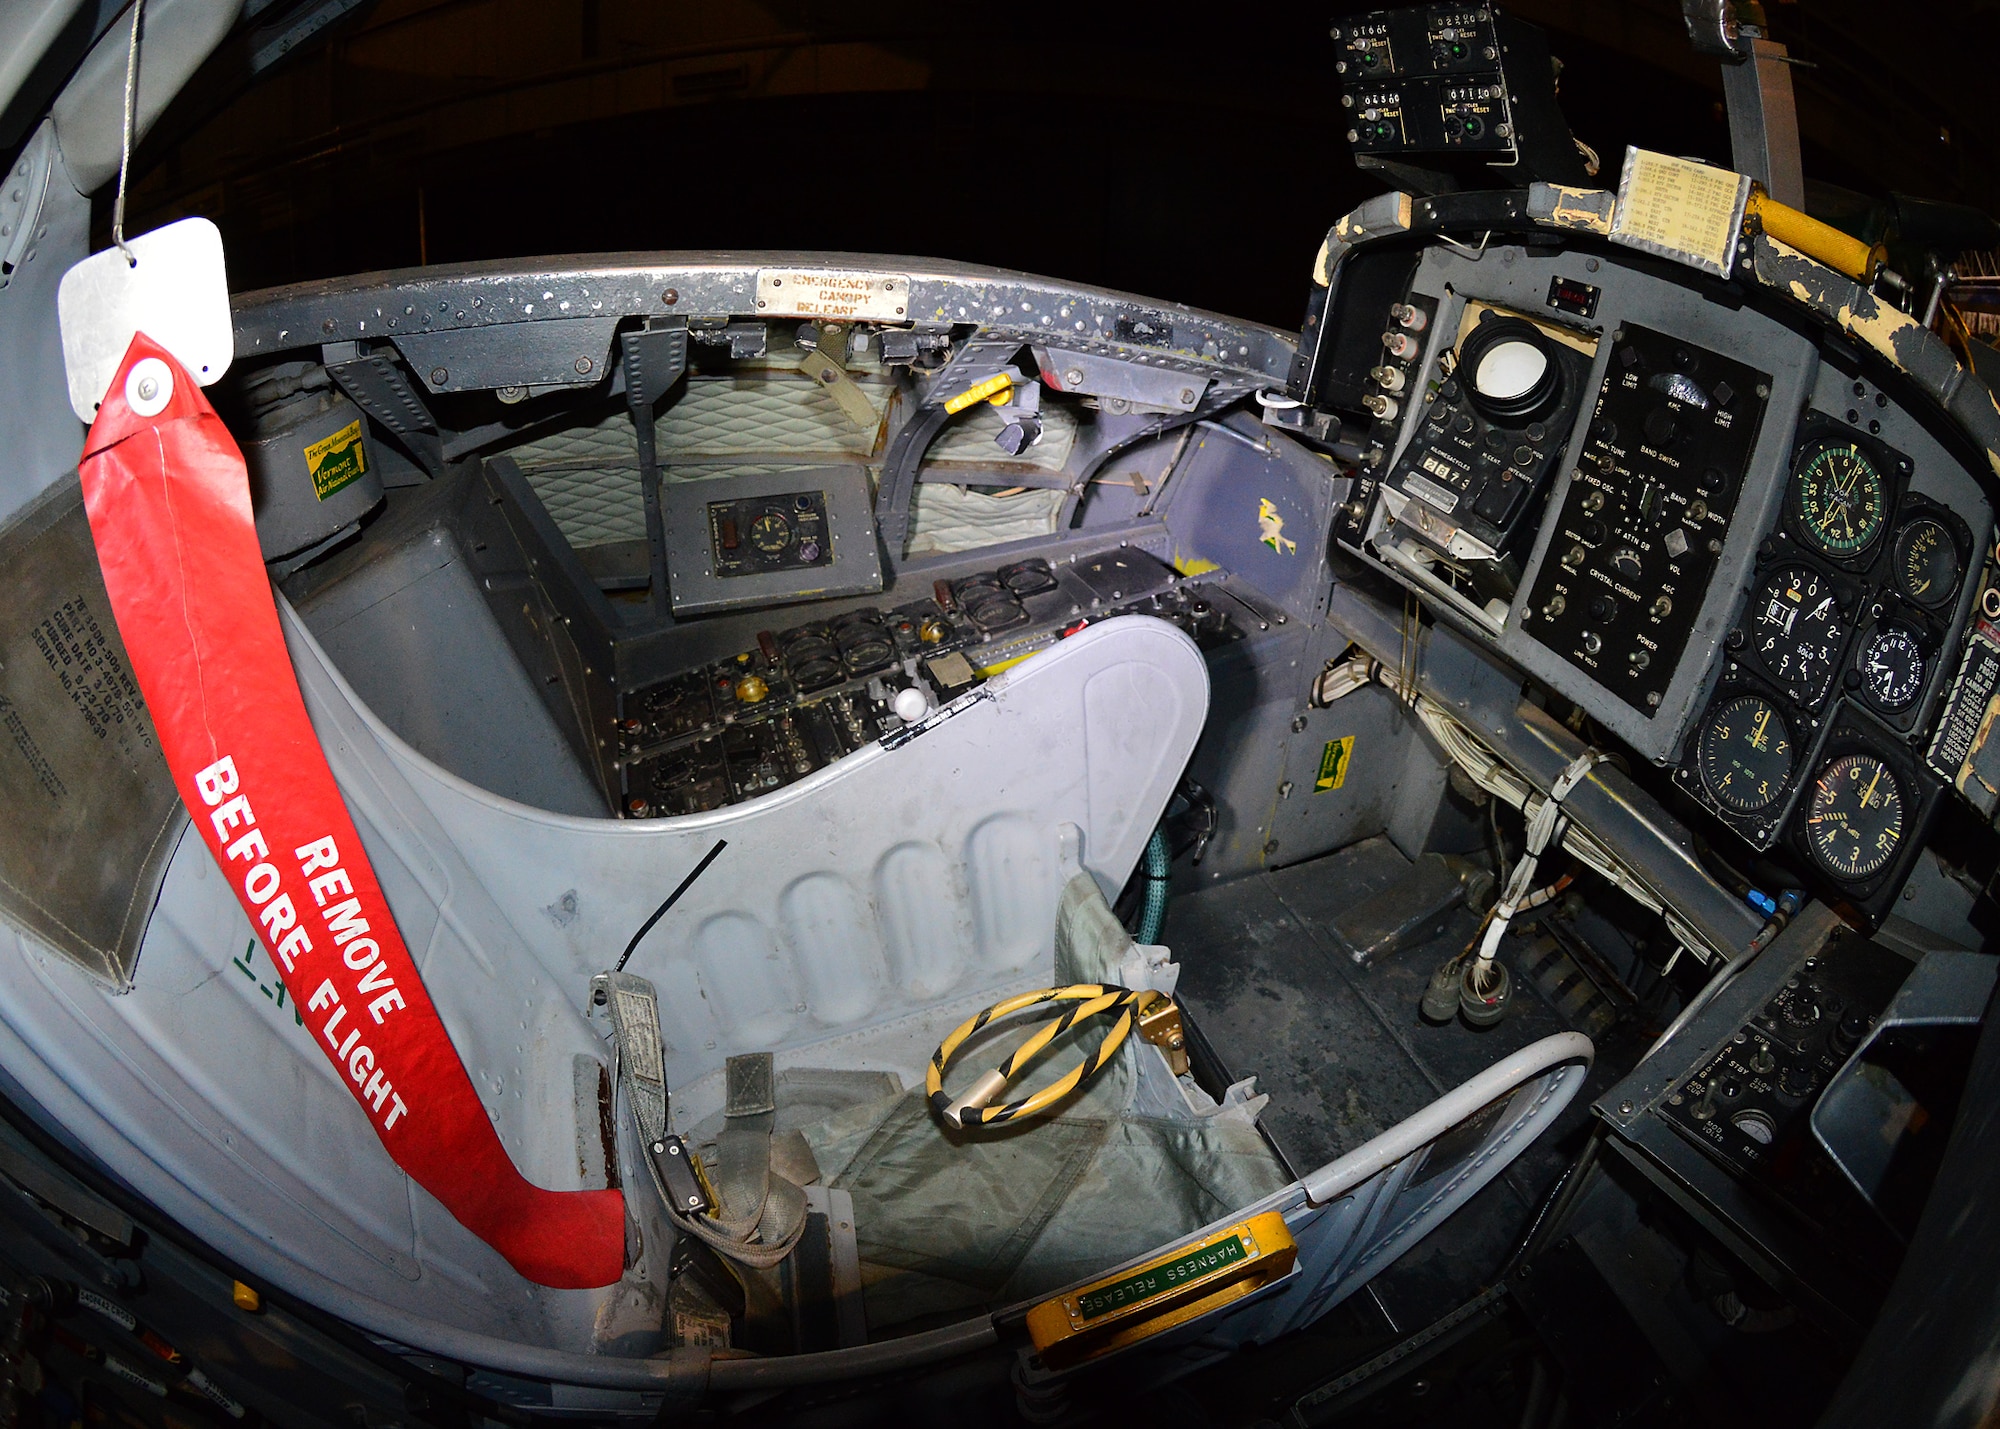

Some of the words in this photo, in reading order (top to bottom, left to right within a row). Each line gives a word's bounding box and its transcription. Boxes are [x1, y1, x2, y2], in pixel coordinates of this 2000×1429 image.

[793, 274, 871, 291] EMERGENCY
[819, 290, 872, 305] CANOPY
[1622, 379, 1638, 390] LIMIT
[1625, 373, 1638, 383] LOW
[1667, 401, 1682, 412] KMC
[1716, 409, 1733, 421] HIGH
[1428, 422, 1445, 434] FOCUS
[1714, 416, 1731, 429] LIMIT
[1610, 445, 1627, 458] TUNE
[1640, 444, 1658, 458] BAND
[1658, 453, 1680, 469] SWITCH
[317, 457, 352, 484] Vermont
[1507, 466, 1534, 484] INTENSITY
[1584, 474, 1601, 487] FIXED
[1583, 510, 1594, 518] OFF
[1670, 491, 1687, 506] BAND
[1707, 511, 1726, 526] WIDTH
[1681, 517, 1702, 531] NARROW
[1565, 529, 1582, 542] SECTOR
[1623, 532, 1640, 546] ATTN
[1640, 541, 1651, 552] DB
[1669, 563, 1681, 576] VOL
[1555, 583, 1568, 595] BFO
[1589, 568, 1614, 588] CRYSTAL
[1614, 583, 1642, 603] CURRENT
[1661, 583, 1676, 595] AGC
[1792, 578, 1801, 590] 9
[1807, 583, 1818, 597] 0
[1773, 589, 1780, 598] 8
[62, 601, 86, 634] PART
[1544, 614, 1555, 623] OFF
[1650, 616, 1661, 625] OFF
[1826, 625, 1837, 639] 2
[31, 627, 59, 672] SERIAL
[41, 618, 73, 667] PURGED
[53, 610, 75, 643] CURE
[71, 642, 93, 675] DATE
[1636, 633, 1658, 652] POWER
[1765, 637, 1776, 649] 6
[1880, 642, 1889, 653] 10
[1889, 638, 1897, 648] 11
[1898, 639, 1906, 651] 12
[1574, 649, 1585, 661] LINE
[1584, 656, 1598, 669] VOLTS
[1818, 646, 1828, 660] 3
[1873, 651, 1880, 660] 9
[1907, 649, 1912, 658] 1
[1780, 654, 1790, 668] 5
[1799, 660, 1808, 674] 4
[1909, 661, 1916, 671] 2
[1628, 669, 1639, 678] OFF
[1876, 675, 1882, 685] 7
[1907, 673, 1915, 684] 3
[1974, 671, 1983, 683] TO
[1892, 687, 1900, 697] 5
[1901, 683, 1907, 693] 4
[1965, 677, 1987, 697] CANOPY
[924, 709, 953, 730] SHOULDER
[1754, 710, 1764, 723] 6
[1720, 726, 1731, 740] 5
[1950, 722, 1972, 743] HANDLE
[1775, 740, 1786, 755] 2
[1942, 743, 1964, 763] HANDLE
[1945, 736, 1967, 756] SECOND
[1723, 771, 1732, 785] 4
[1849, 767, 1861, 780] 6
[1758, 780, 1769, 794] 3
[1825, 791, 1838, 805] 5
[1883, 792, 1893, 807] 1
[1826, 828, 1838, 843] 4
[1875, 833, 1887, 850] 2
[1849, 846, 1860, 861] 3
[294, 834, 407, 1025] REMOVE
[194, 754, 314, 974] BEFORE
[307, 977, 408, 1131] FLIGHT
[1728, 1060, 1750, 1076] STBY
[1701, 1125, 1724, 1143] VOLTS
[1166, 1243, 1238, 1282] HARNESS
[1086, 1277, 1157, 1313] RELEASE
